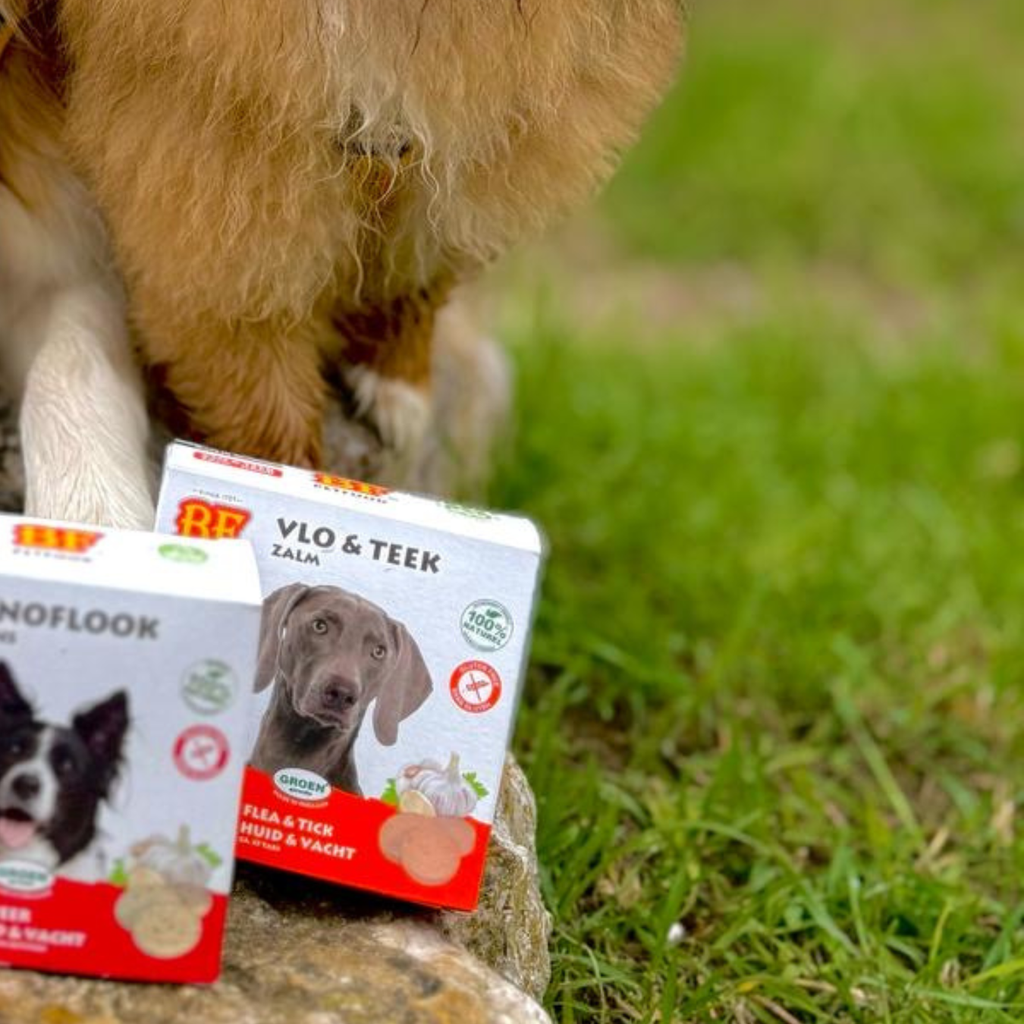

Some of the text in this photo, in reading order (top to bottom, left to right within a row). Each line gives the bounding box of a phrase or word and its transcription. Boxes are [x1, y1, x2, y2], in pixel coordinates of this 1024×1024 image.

[176, 497, 251, 540] BF
[271, 543, 321, 567] ZALM
[277, 518, 442, 575] VLO & TEEK
[467, 610, 507, 640] 100%
[279, 774, 326, 794] GROEN
[243, 804, 335, 837] FLEA & TICK
[239, 820, 283, 842] HUID
[285, 834, 298, 847] &
[300, 836, 356, 861] VACHT
